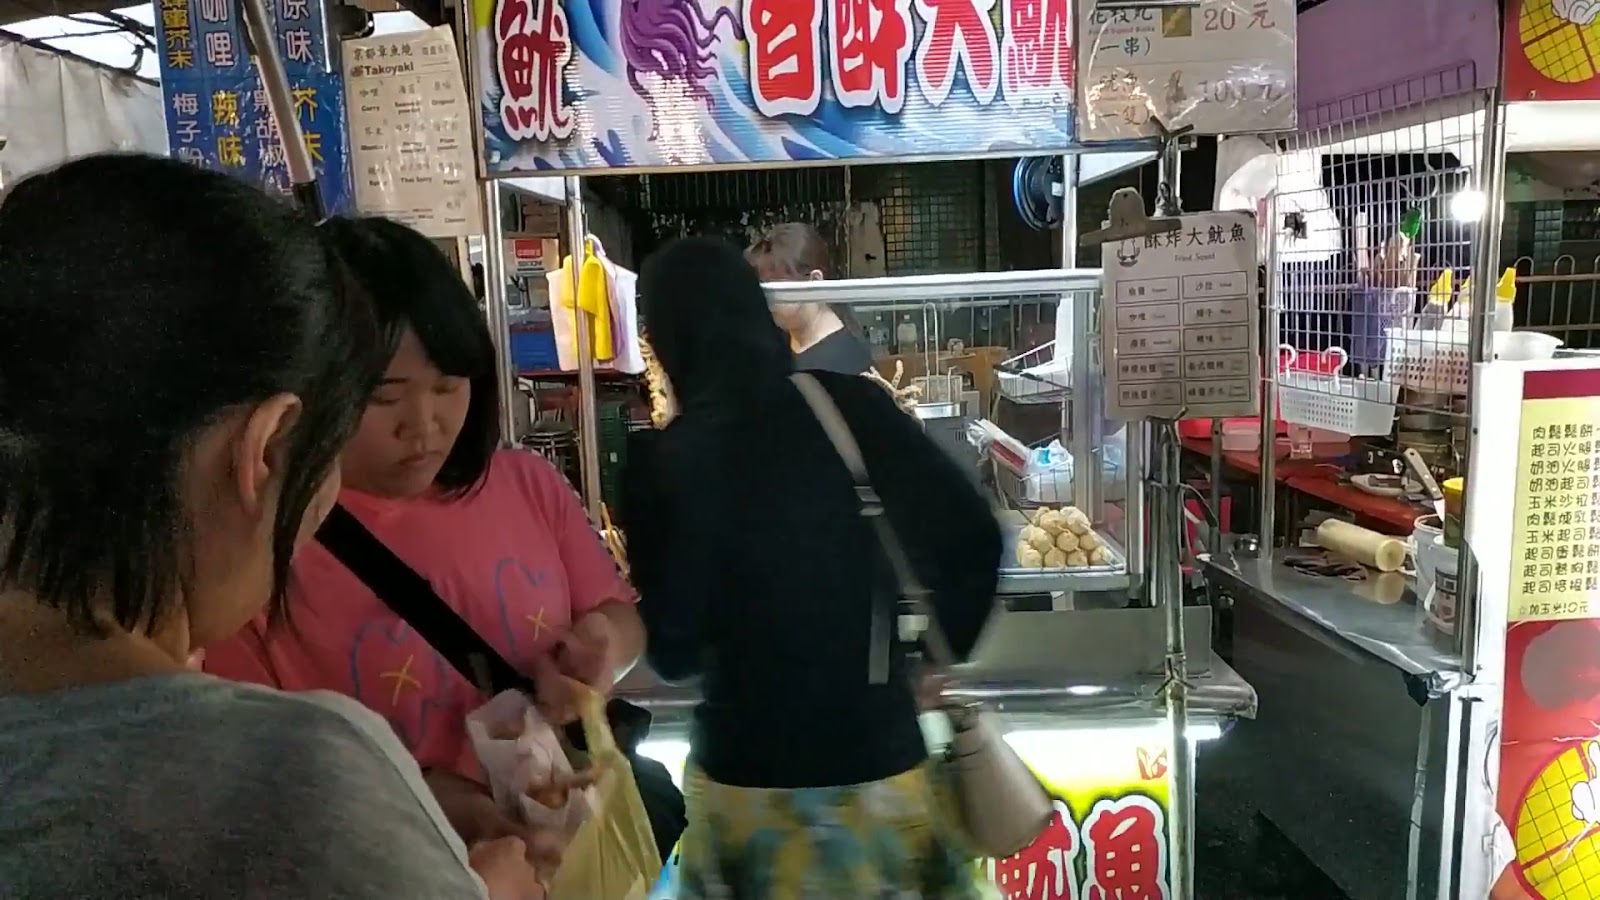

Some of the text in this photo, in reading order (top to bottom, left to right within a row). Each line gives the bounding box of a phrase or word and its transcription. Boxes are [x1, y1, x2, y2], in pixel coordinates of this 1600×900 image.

[1204, 1, 1276, 31] 20 元
[364, 61, 414, 76] Takoyaki
[213, 90, 246, 166] 辣味
